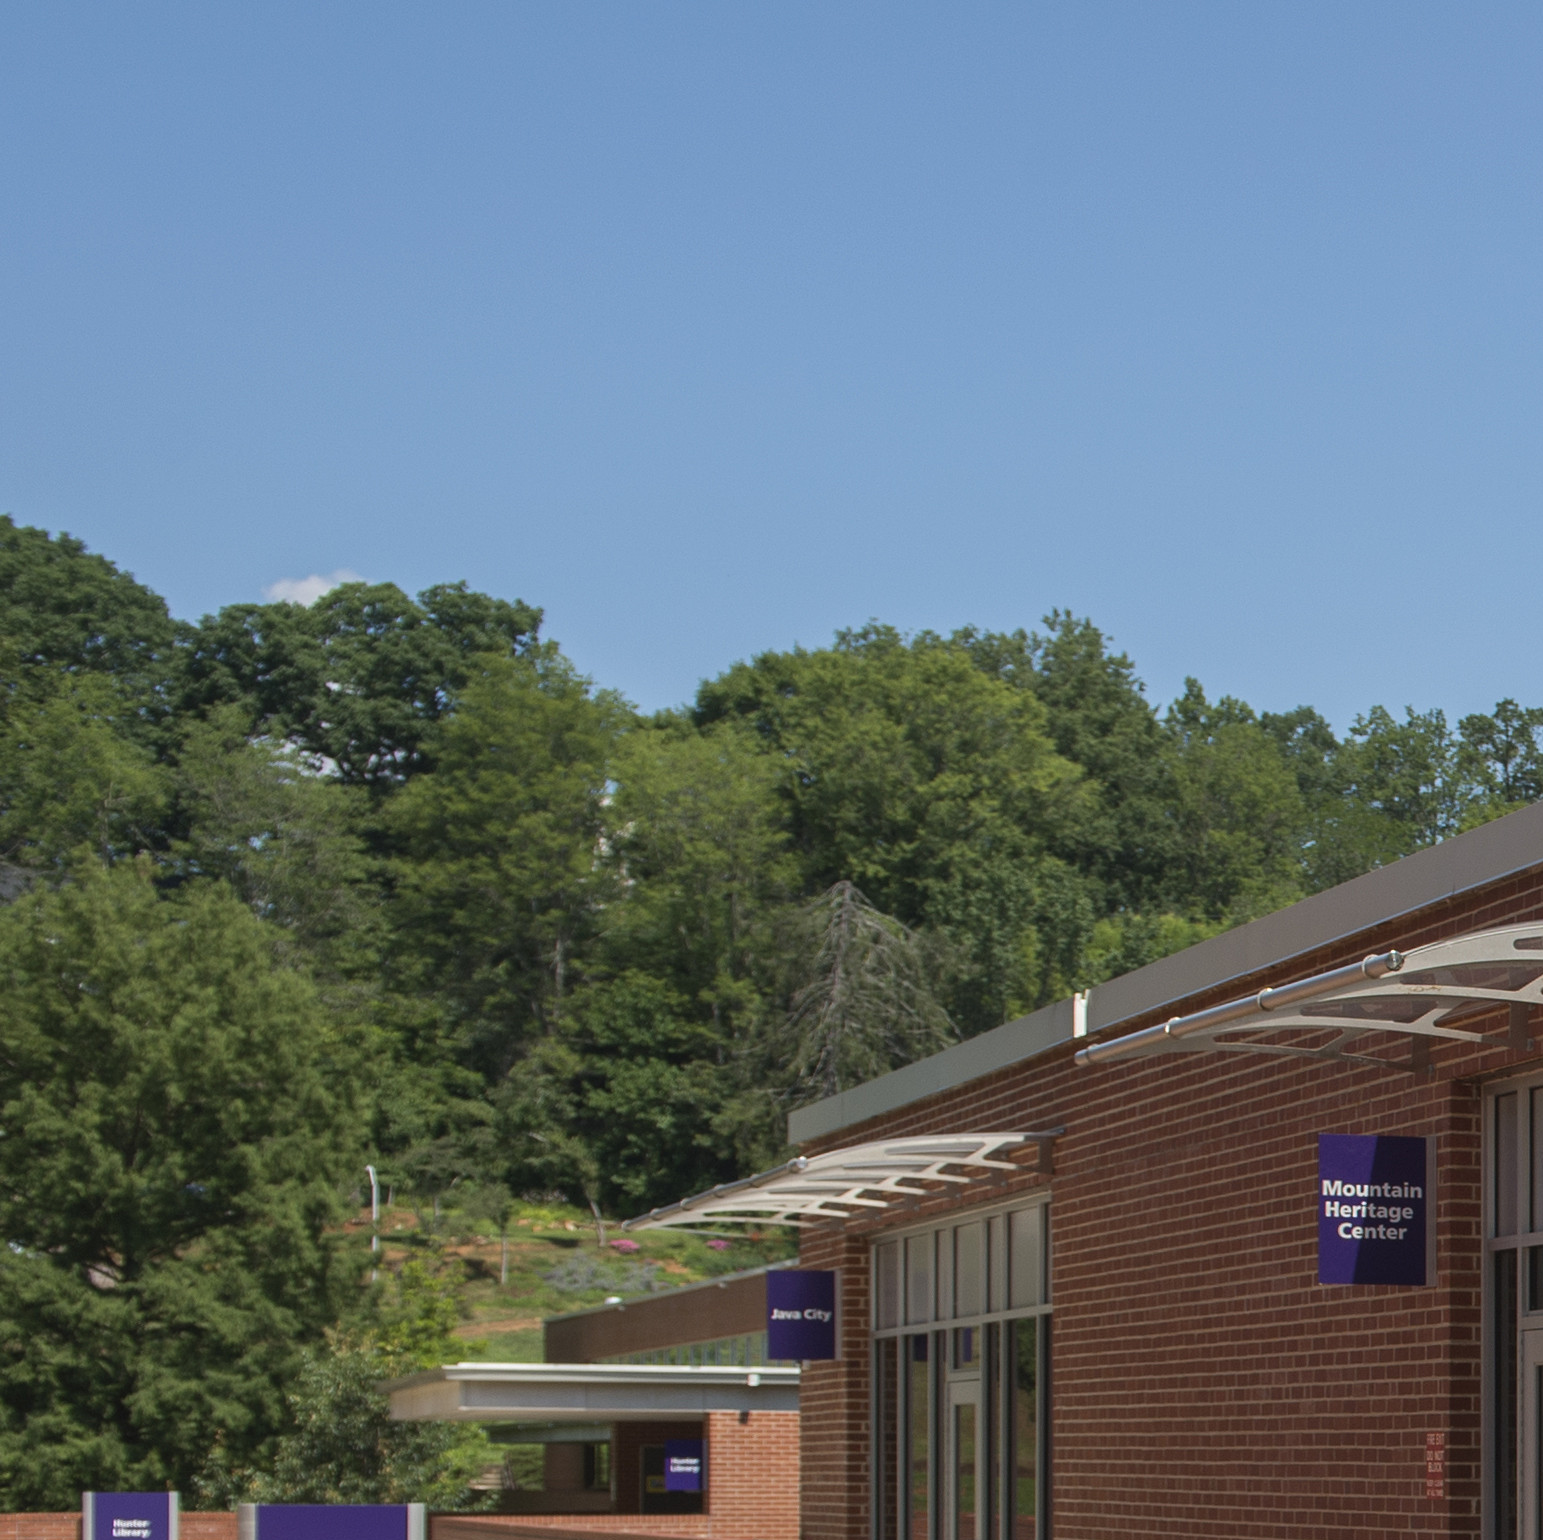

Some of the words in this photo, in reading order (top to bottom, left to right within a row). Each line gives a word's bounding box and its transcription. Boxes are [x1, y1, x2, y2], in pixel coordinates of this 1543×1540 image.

[1322, 1180, 1422, 1198] Mountain
[1325, 1201, 1414, 1222] Heritage
[1338, 1222, 1407, 1240] Center
[771, 1308, 801, 1321] Java
[803, 1308, 832, 1322] City
[113, 1518, 150, 1528] Hunter
[112, 1528, 151, 1539] Library
